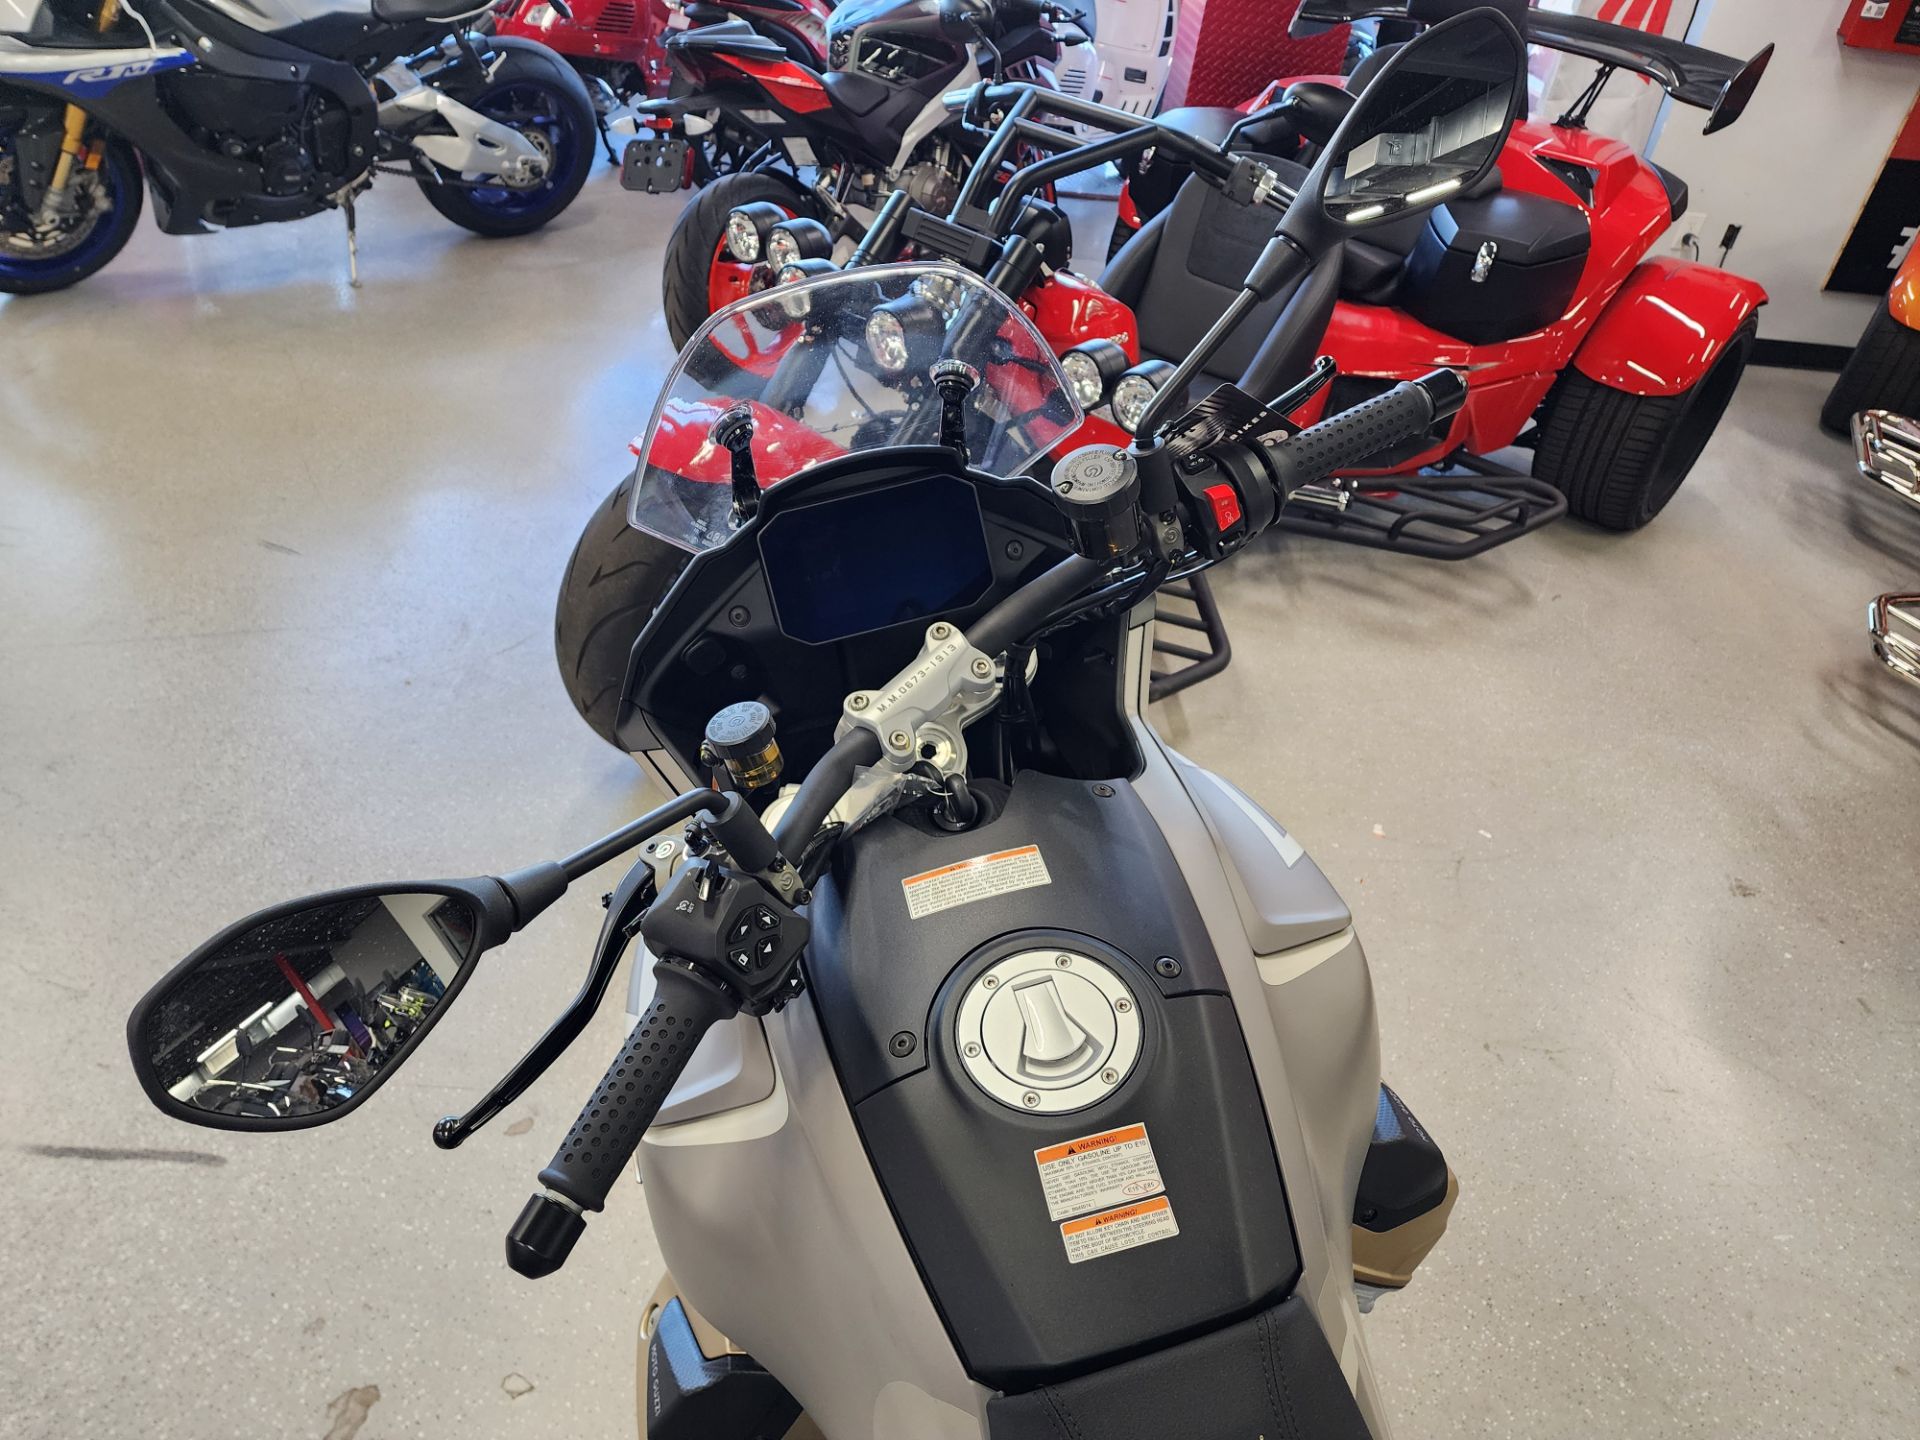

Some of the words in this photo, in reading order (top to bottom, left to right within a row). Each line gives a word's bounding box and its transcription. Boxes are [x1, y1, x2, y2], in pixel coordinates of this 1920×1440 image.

[63, 60, 154, 85] R1M
[877, 644, 957, 713] M.M.0673-1913
[1077, 1134, 1117, 1150] WARNING!
[1042, 1162, 1056, 1171] USE
[1057, 1157, 1075, 1167] ONLY
[1077, 1148, 1110, 1162] GASOLINE
[1134, 1139, 1146, 1147] E10
[1102, 1208, 1138, 1222] WARNING!
